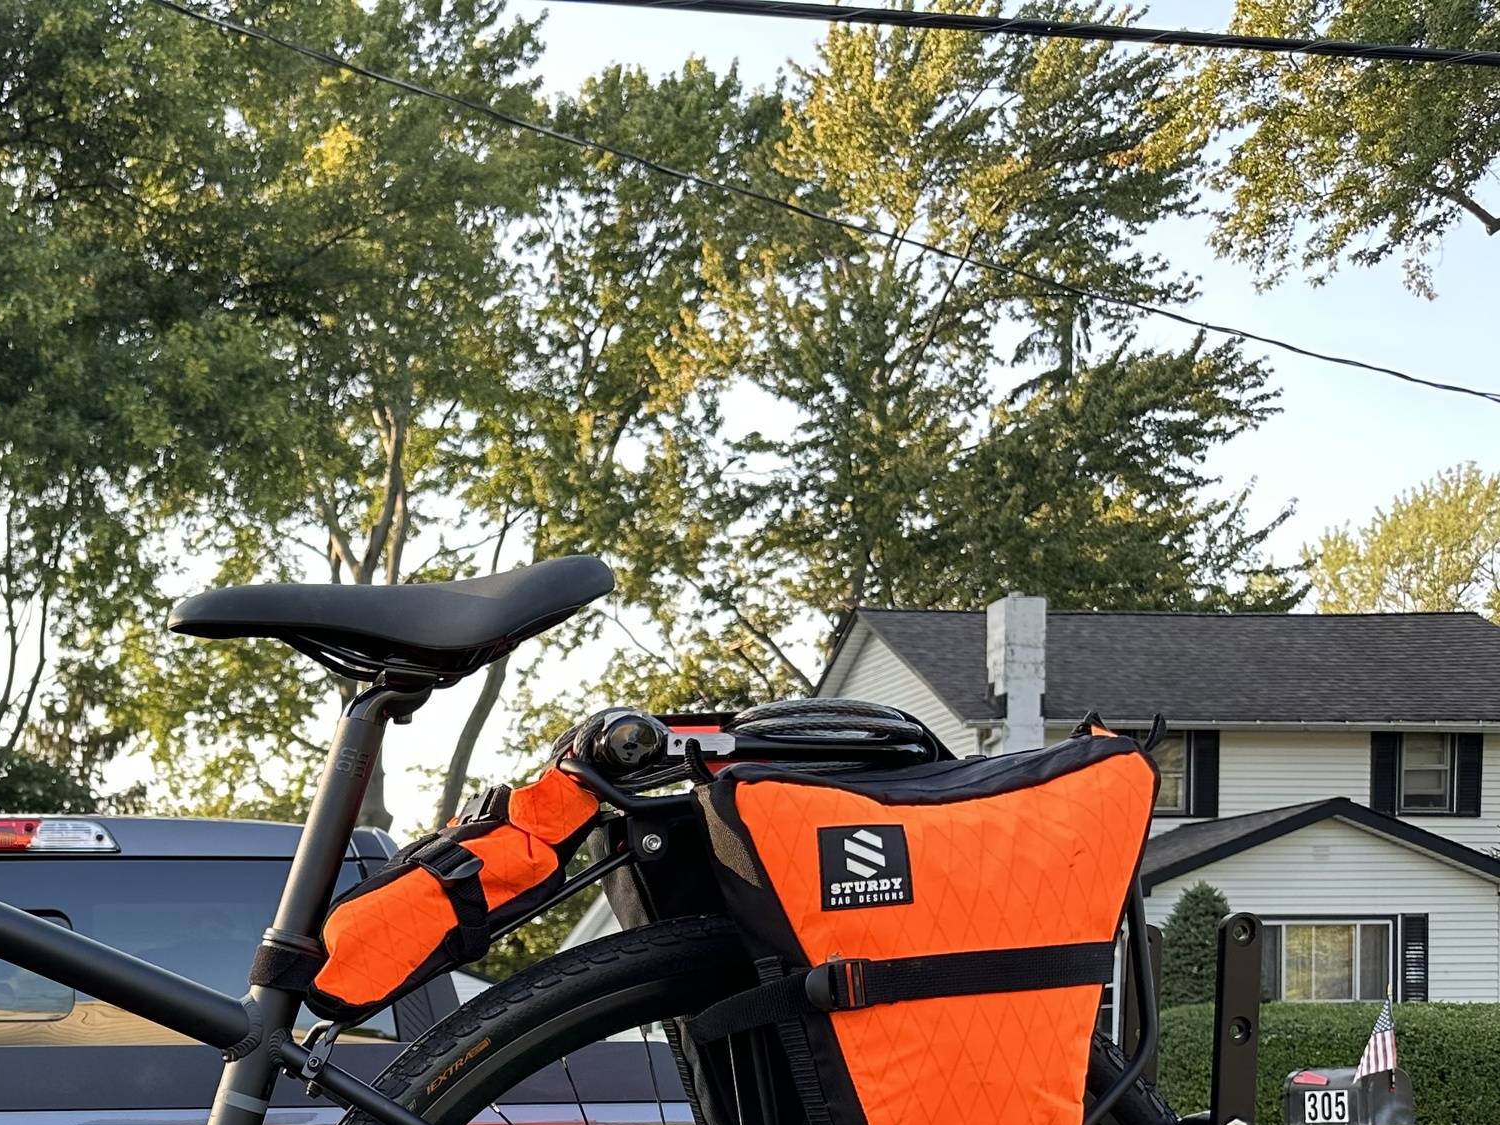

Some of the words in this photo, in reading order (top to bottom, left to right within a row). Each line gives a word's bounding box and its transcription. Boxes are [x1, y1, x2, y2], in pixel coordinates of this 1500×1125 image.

[830, 877, 903, 895] STURDY
[830, 896, 851, 906] BAG
[858, 890, 905, 904] DESIGNS
[1307, 1092, 1346, 1121] 305
